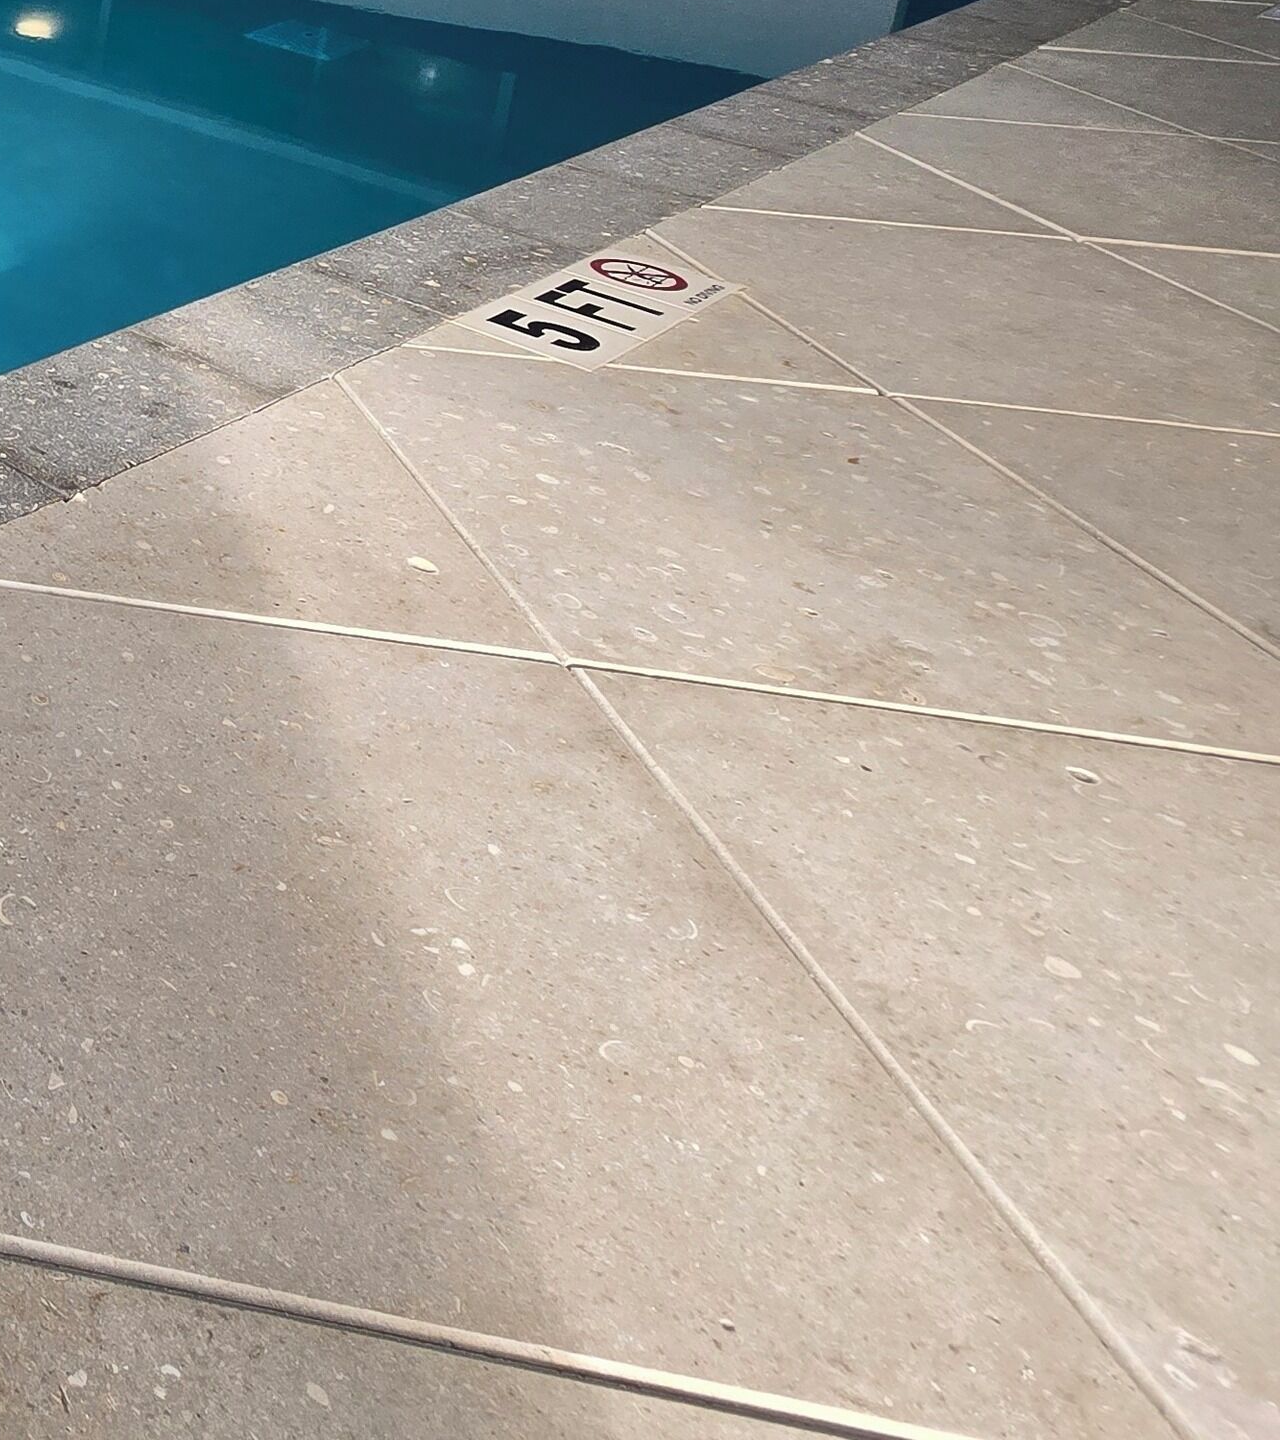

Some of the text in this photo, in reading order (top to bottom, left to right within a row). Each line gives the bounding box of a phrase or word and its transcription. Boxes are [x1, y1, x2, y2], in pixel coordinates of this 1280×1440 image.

[486, 279, 664, 351] 5 FT
[683, 285, 725, 305] NO DIVING
